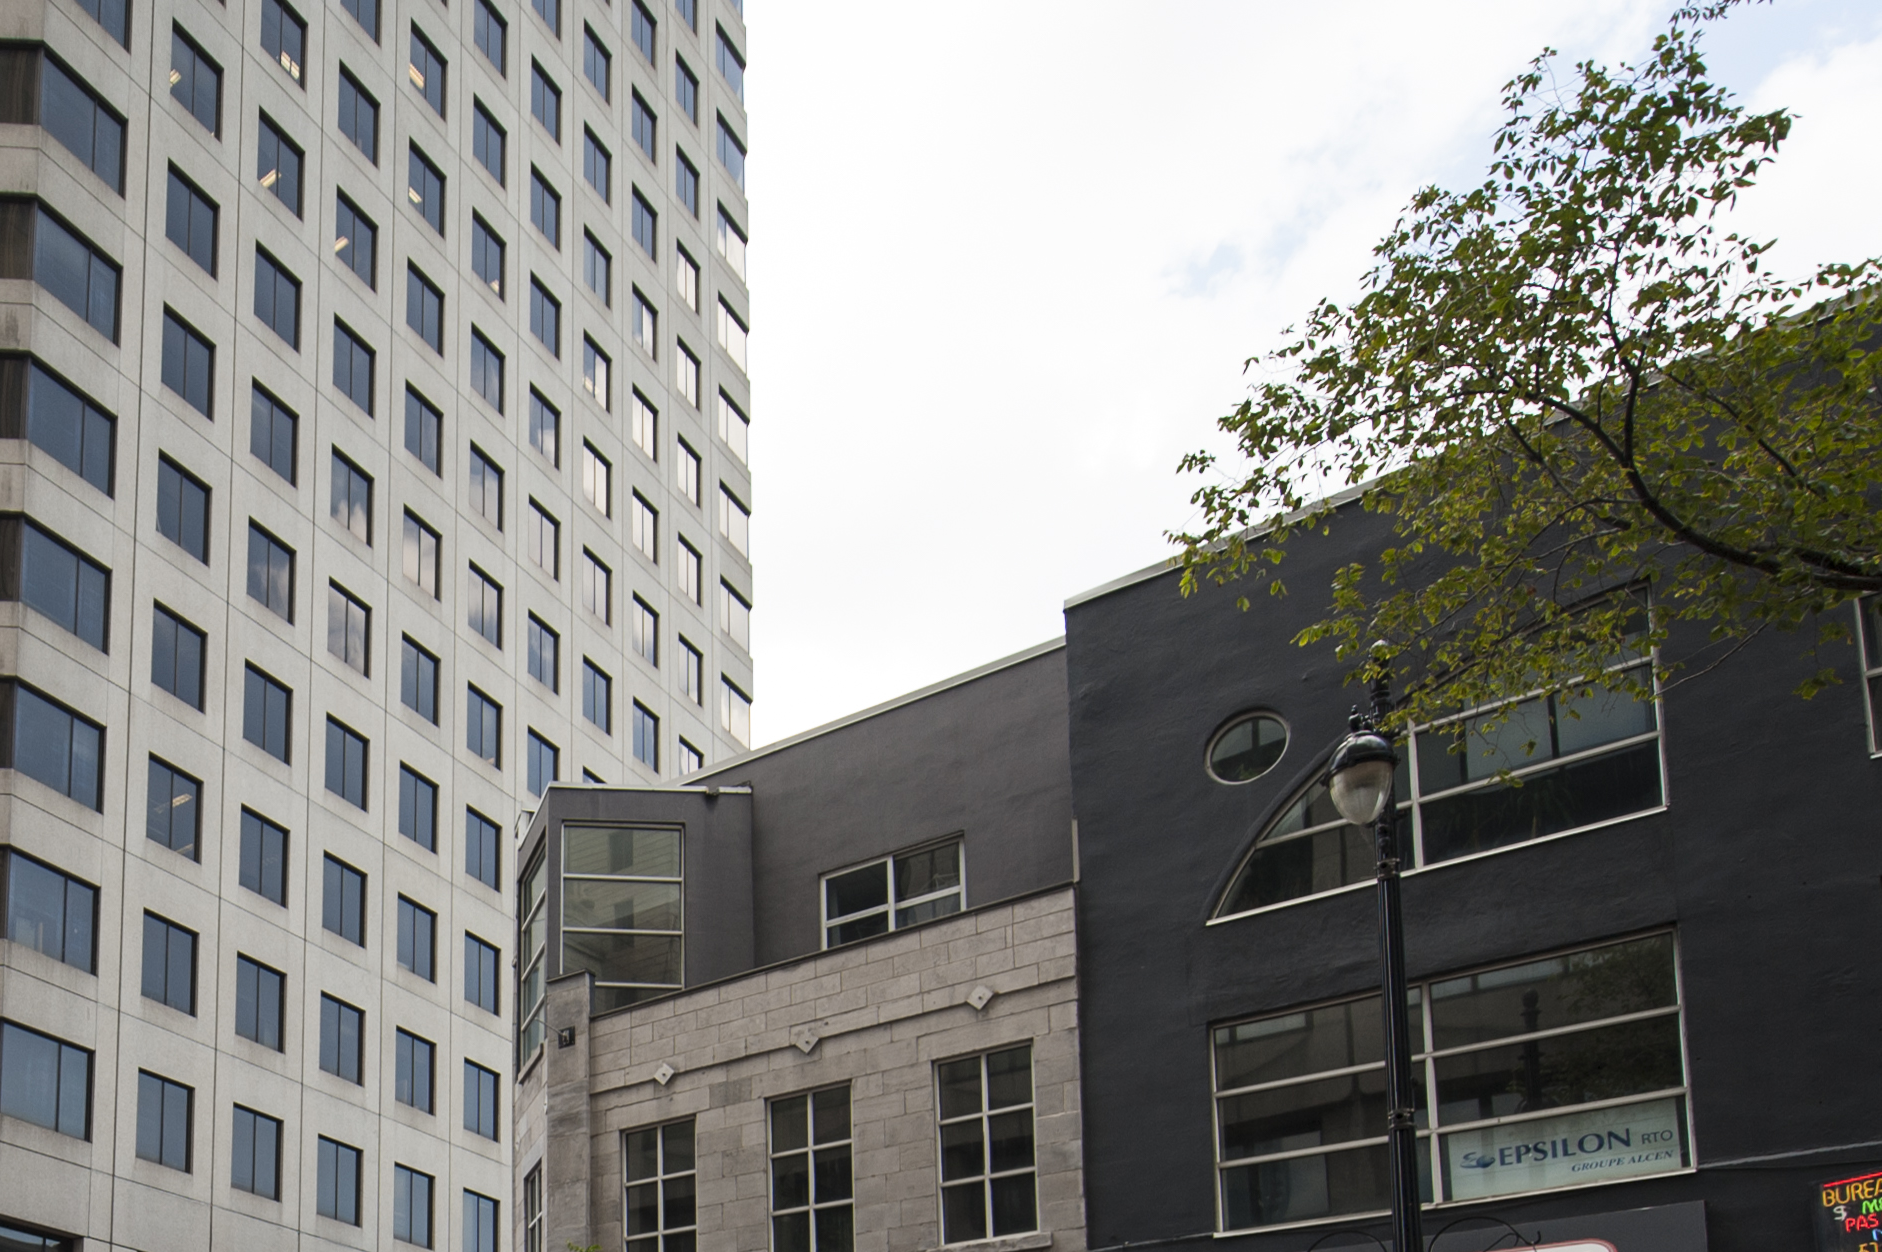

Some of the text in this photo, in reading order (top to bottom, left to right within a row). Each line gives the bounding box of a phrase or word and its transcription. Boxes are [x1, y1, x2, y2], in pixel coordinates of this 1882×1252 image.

[1498, 1127, 1674, 1168] EPSILON RTO
[1571, 1149, 1675, 1173] GROUPE ALCEN
[1845, 1212, 1880, 1234] PAS
